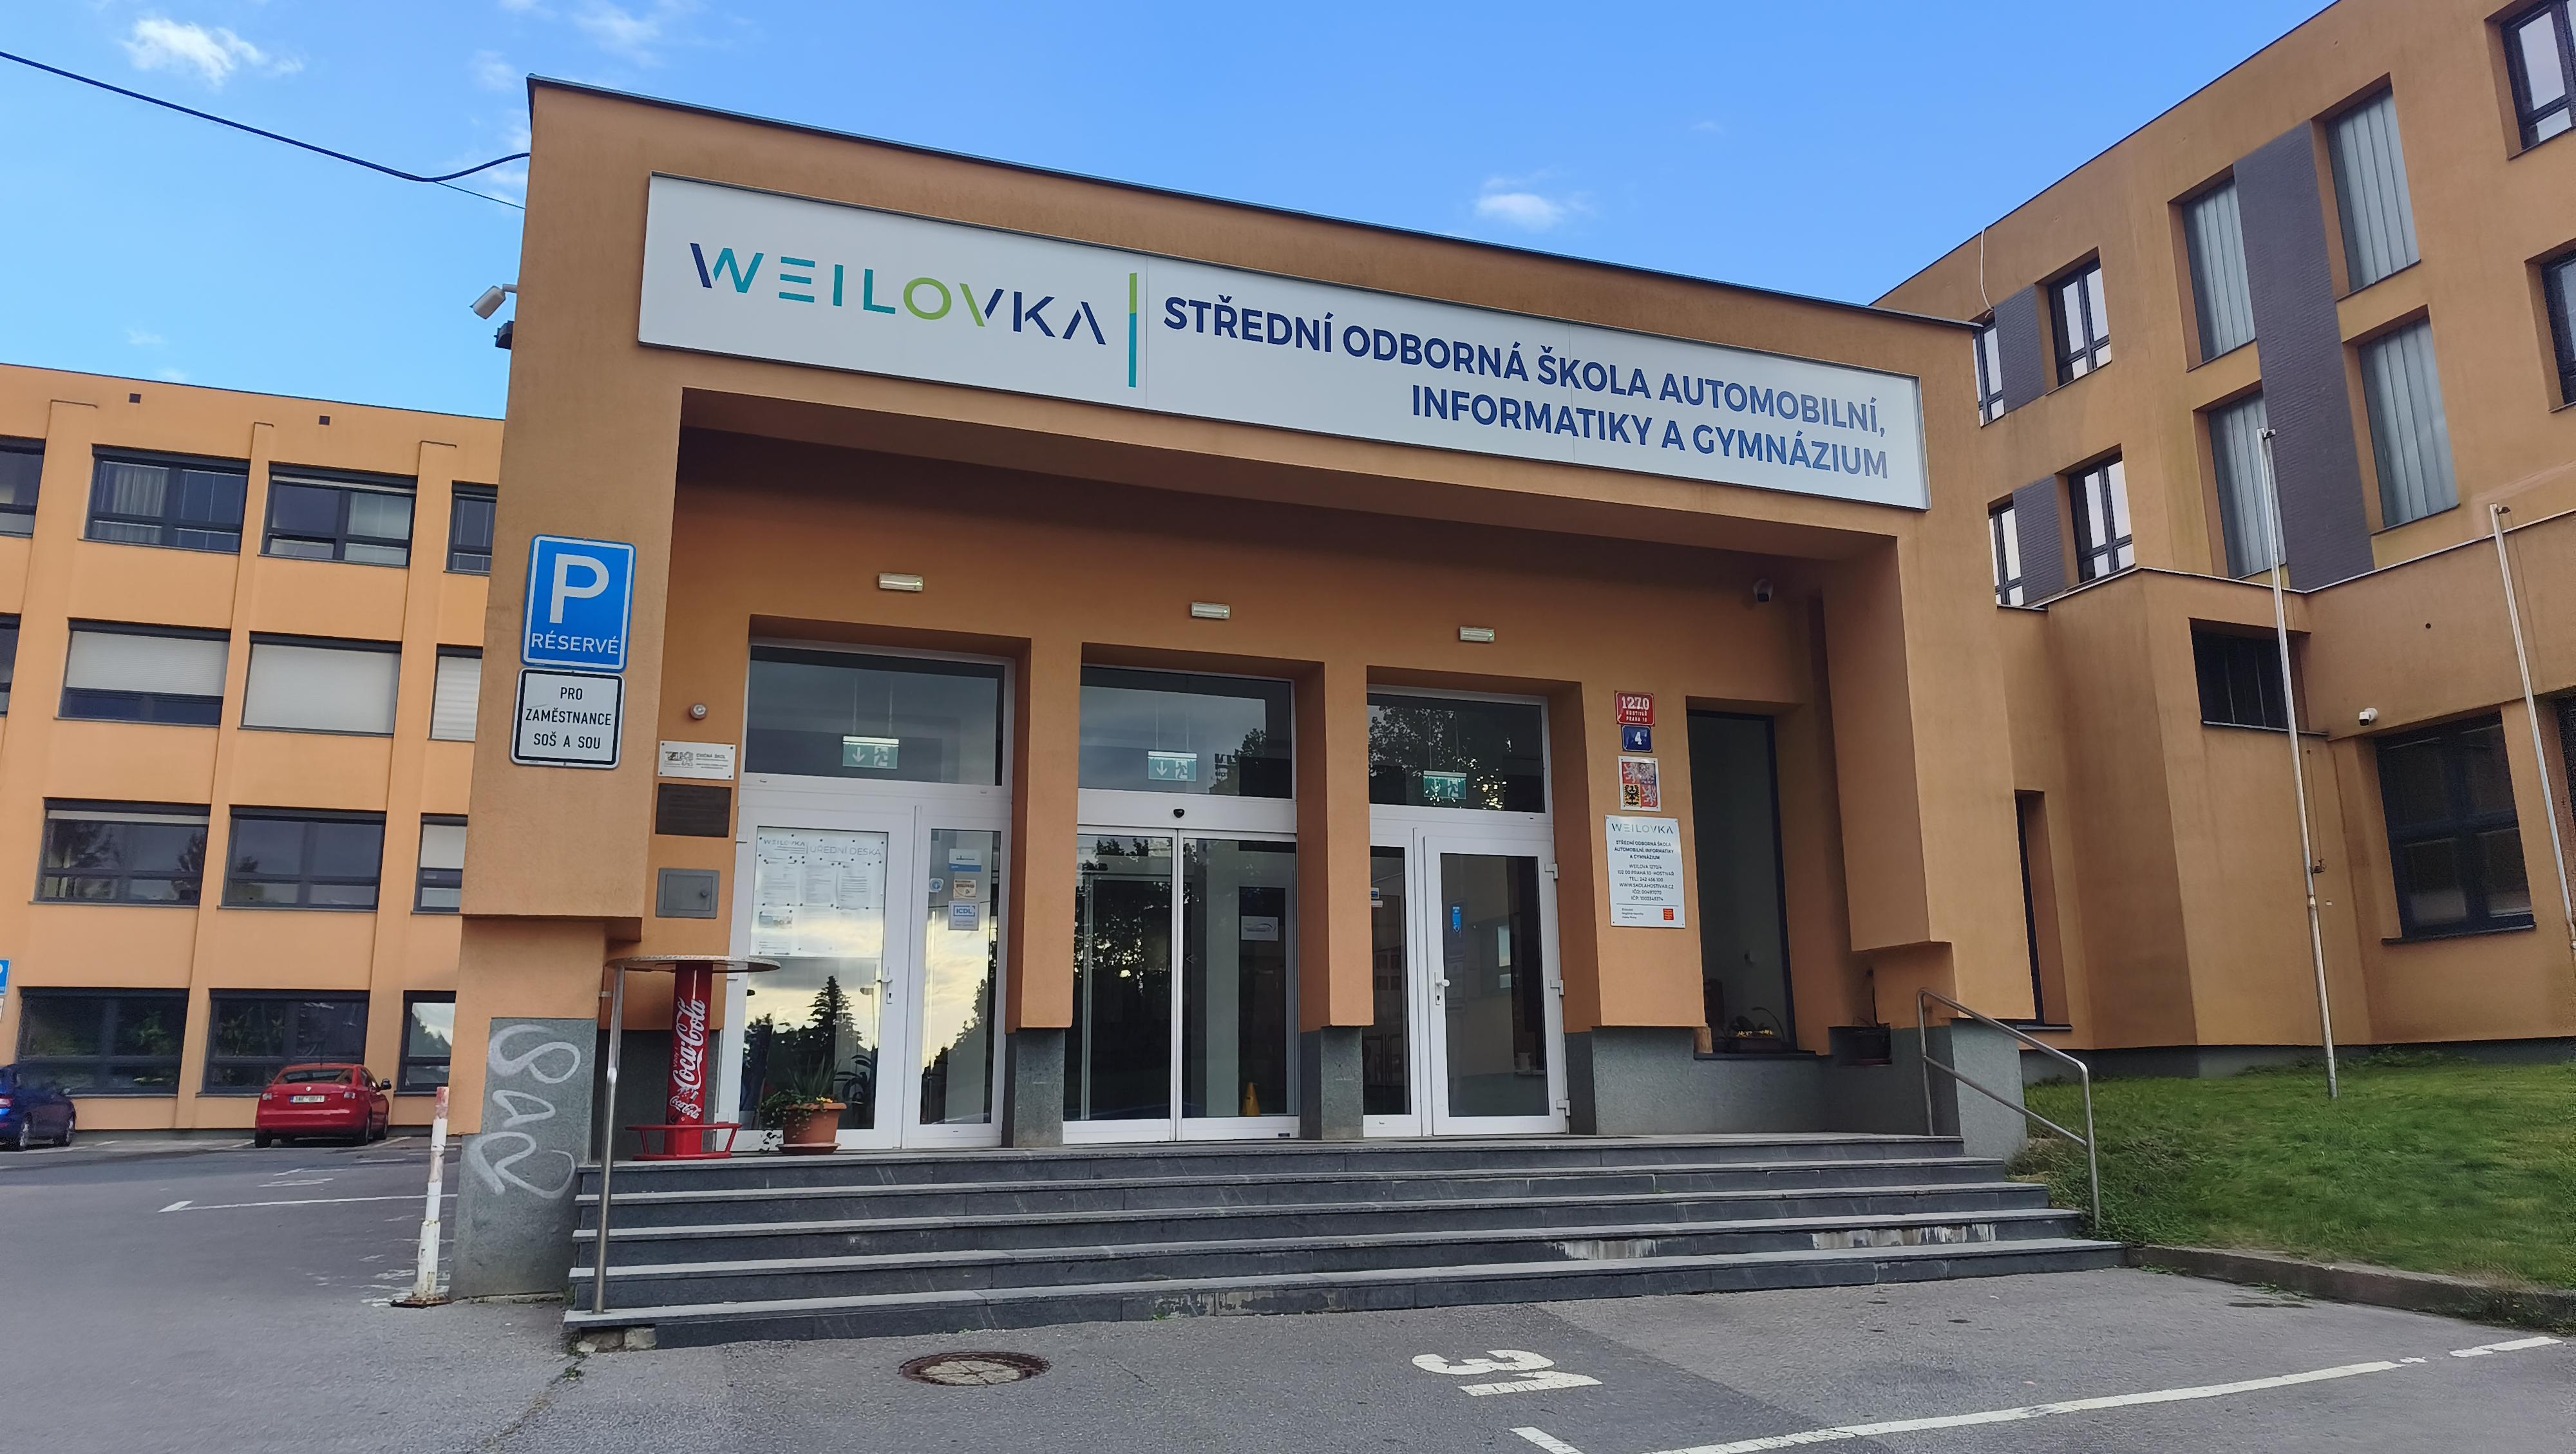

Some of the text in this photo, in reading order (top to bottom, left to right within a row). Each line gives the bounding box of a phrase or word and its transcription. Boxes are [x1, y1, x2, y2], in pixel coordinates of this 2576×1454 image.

[690, 242, 1106, 345] WEILOVKA
[1164, 294, 1886, 437] STŘEDNÍ ODBORNÁ ŠKOLA AUTOMOBILNÍ,
[1412, 384, 1888, 479] INFORMATIKY A GYMNÁZIUM
[549, 553, 609, 624] P
[531, 630, 619, 655] RÉSERVÉ
[560, 686, 583, 701] PRO
[1622, 696, 1650, 710] 1270
[526, 707, 612, 726] ZAMĚSTNANCE
[533, 732, 601, 750] SOŠ A SOU
[1634, 732, 1642, 745] 4
[1611, 823, 1673, 834] WEILOVKA
[849, 847, 881, 856] DESKA
[673, 996, 705, 1090] Coca-Cola
